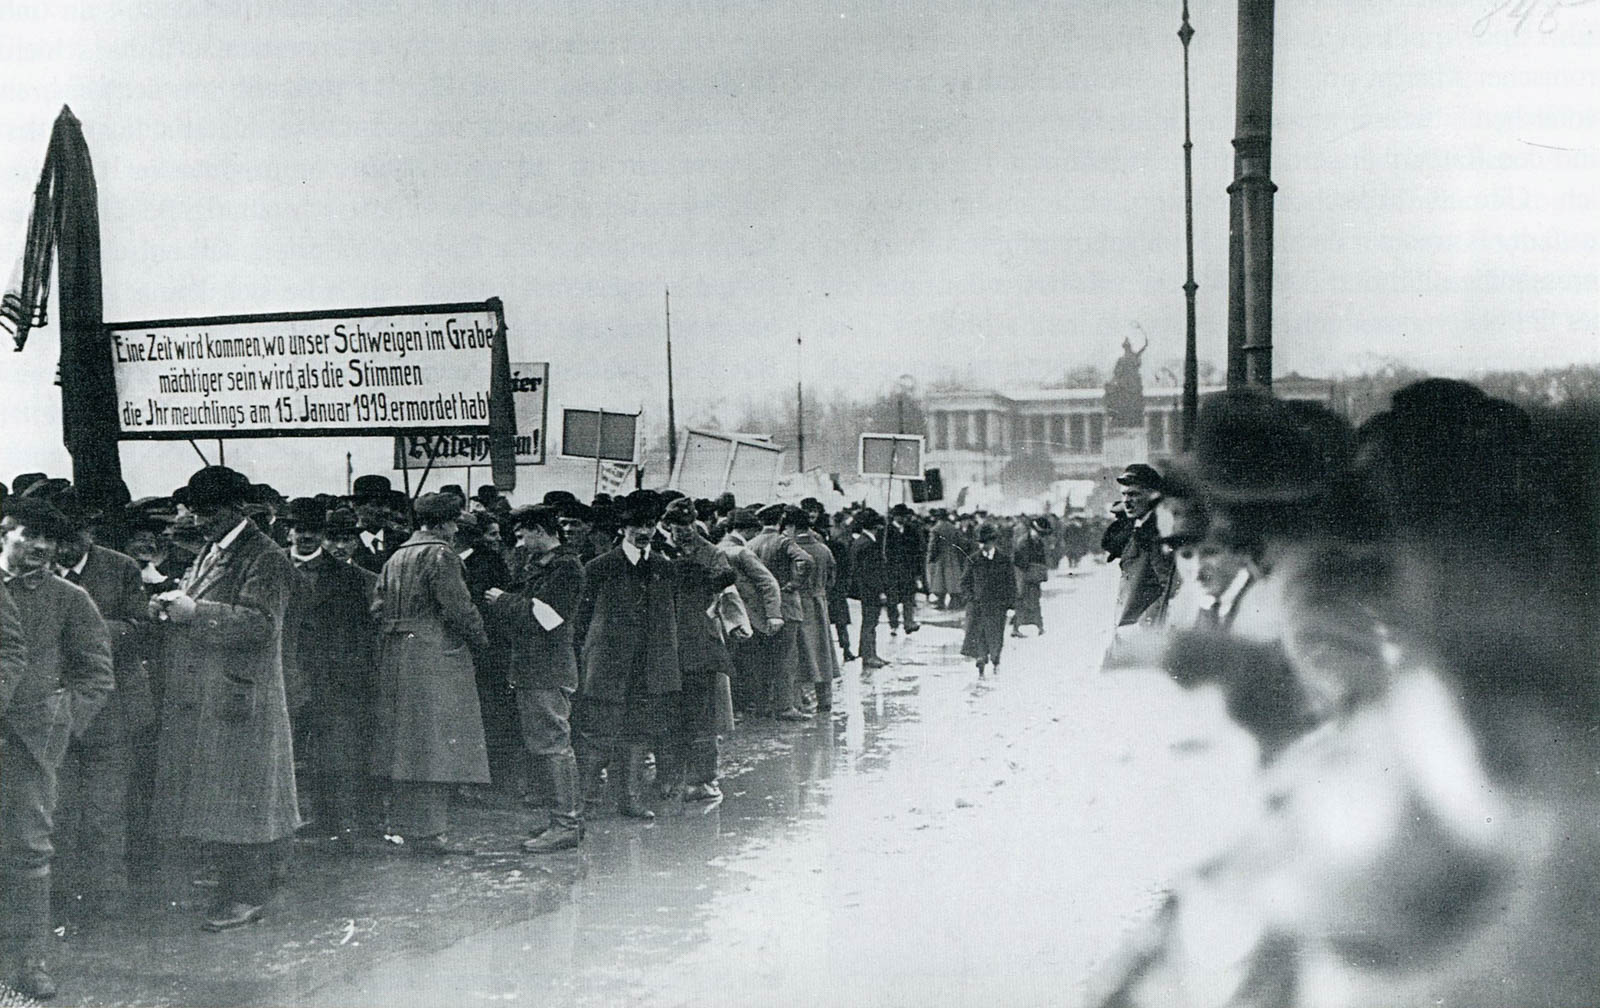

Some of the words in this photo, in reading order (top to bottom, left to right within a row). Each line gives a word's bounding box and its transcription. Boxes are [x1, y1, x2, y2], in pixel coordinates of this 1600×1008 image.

[114, 335, 145, 363] Eine
[147, 333, 172, 361] Zeit
[173, 333, 203, 360] wird
[206, 332, 265, 359] kommen,
[263, 335, 285, 355] wo
[289, 334, 330, 356] unser
[334, 323, 423, 358] Schweigen
[425, 321, 446, 351] im
[446, 318, 494, 350] Grabe
[160, 366, 224, 397] mächtiger
[228, 363, 257, 391] sein
[259, 362, 299, 392] wird,
[298, 362, 319, 390] als
[322, 361, 344, 388] die
[348, 358, 424, 388] Stimmen
[123, 401, 142, 426] die
[171, 399, 245, 428] meuchlings
[250, 404, 271, 423] am
[275, 397, 297, 423] 15.
[300, 395, 351, 423] Januar
[353, 392, 391, 422] 1919.
[391, 393, 458, 422] ermordet
